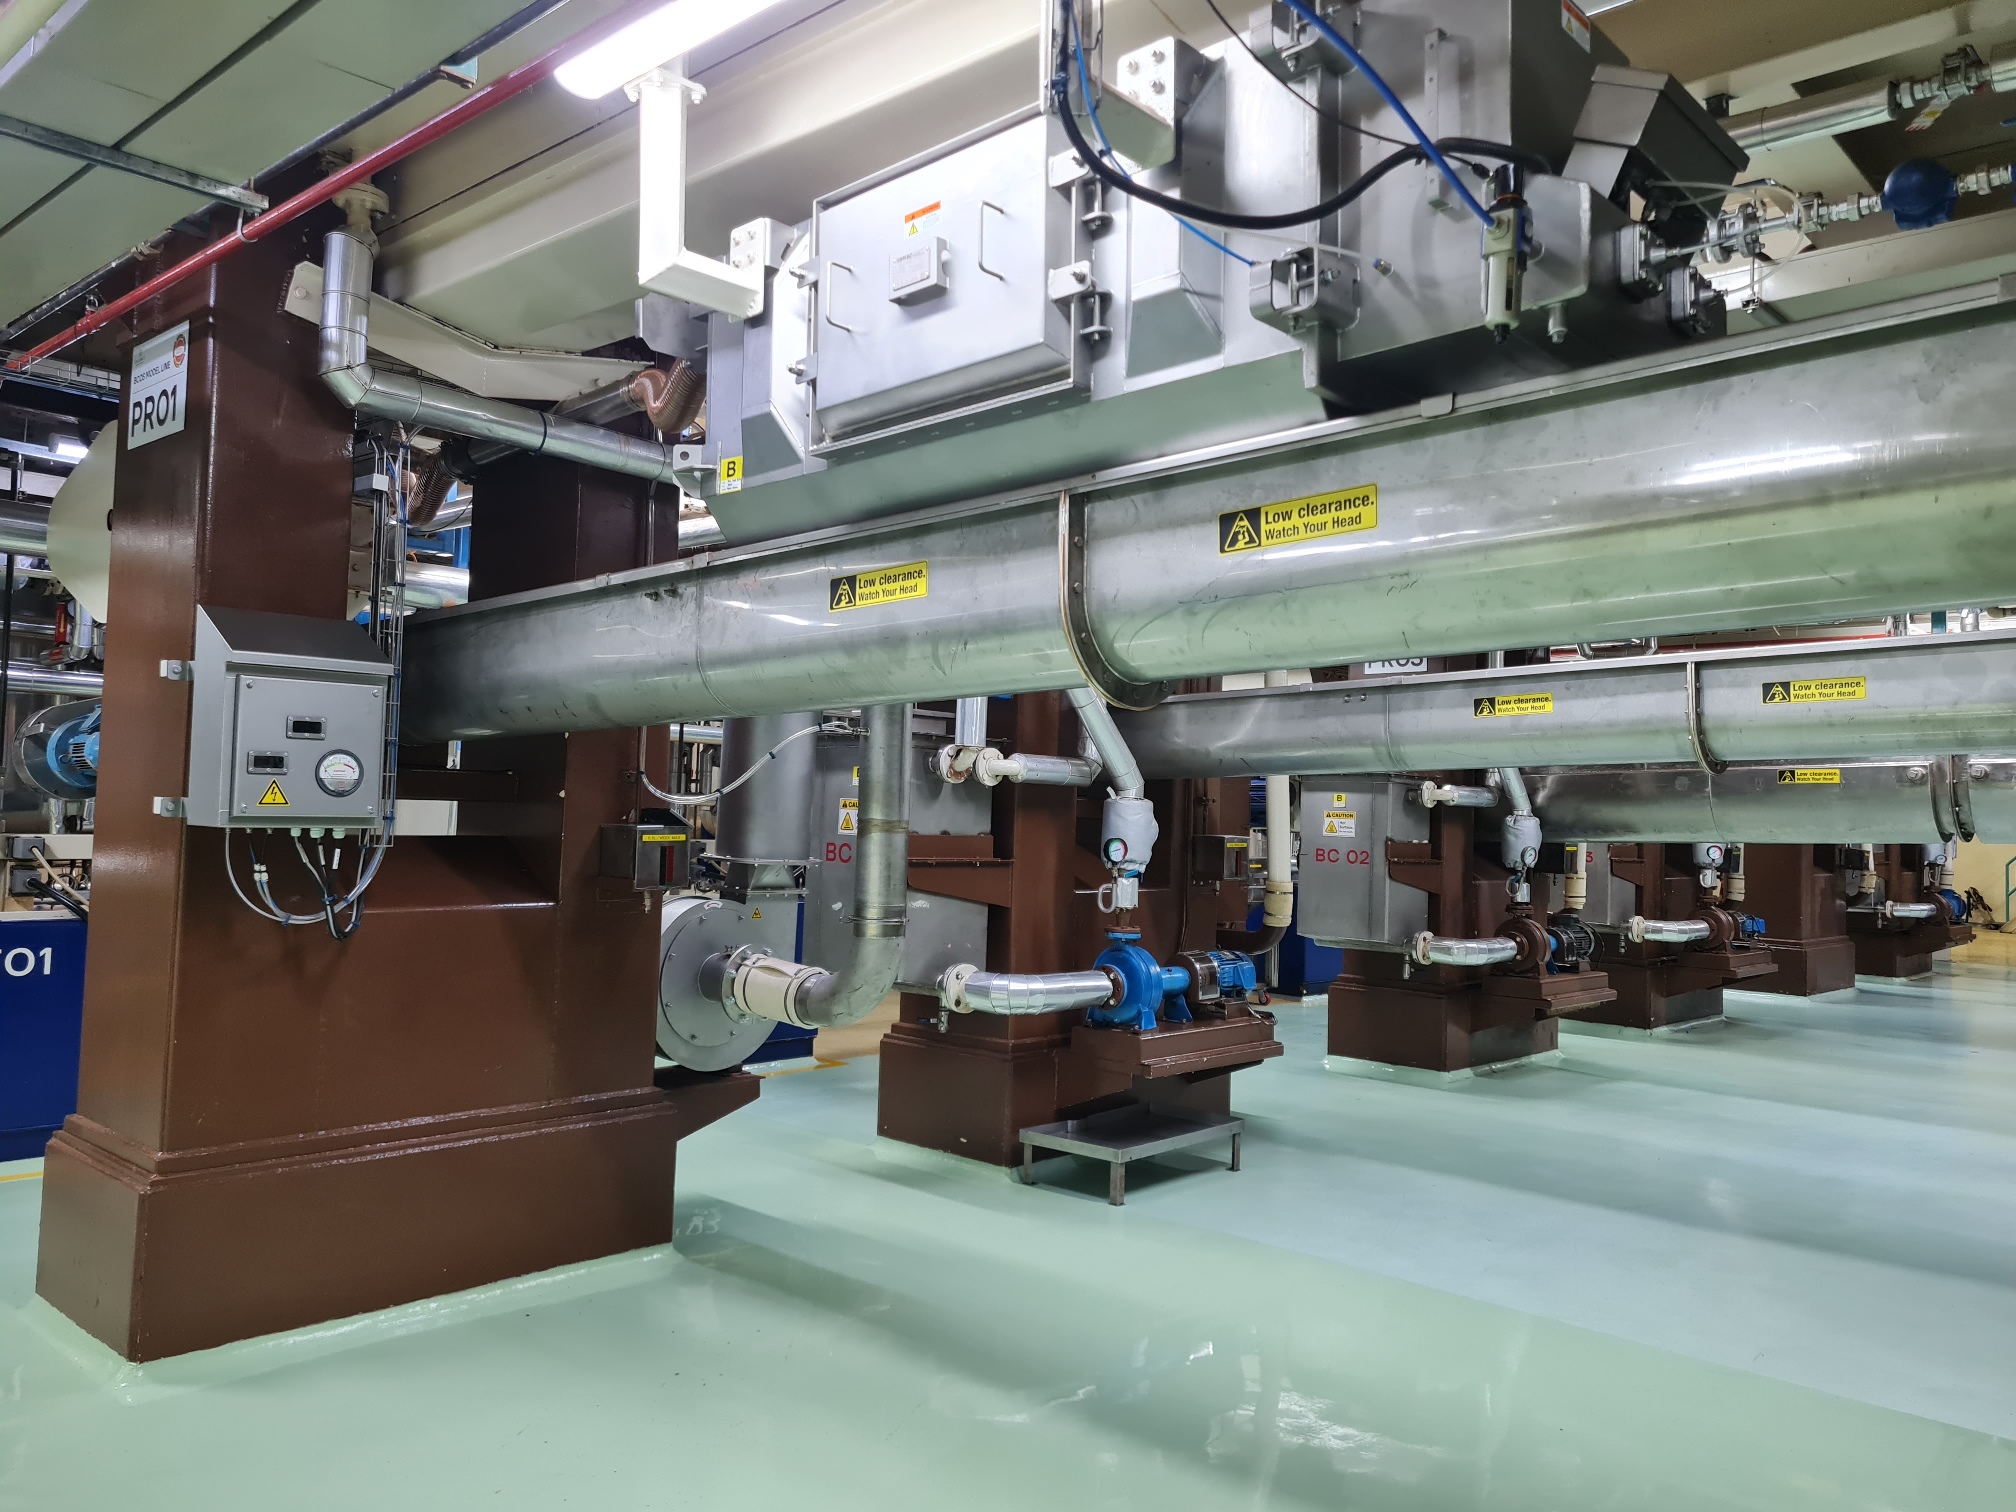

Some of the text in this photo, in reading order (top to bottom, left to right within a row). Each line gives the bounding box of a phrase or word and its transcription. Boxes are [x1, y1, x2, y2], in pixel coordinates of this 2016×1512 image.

[726, 460, 736, 478] B
[1264, 494, 1374, 525] Low clearance.
[1265, 512, 1362, 541] Watch Your Head
[858, 568, 926, 589] Low clearance.
[858, 582, 918, 602] Watch Your Head
[1793, 680, 1864, 692] Low clearance.
[1514, 696, 1551, 705] clearance.
[826, 842, 852, 864] BC
[1316, 848, 1340, 863] BC
